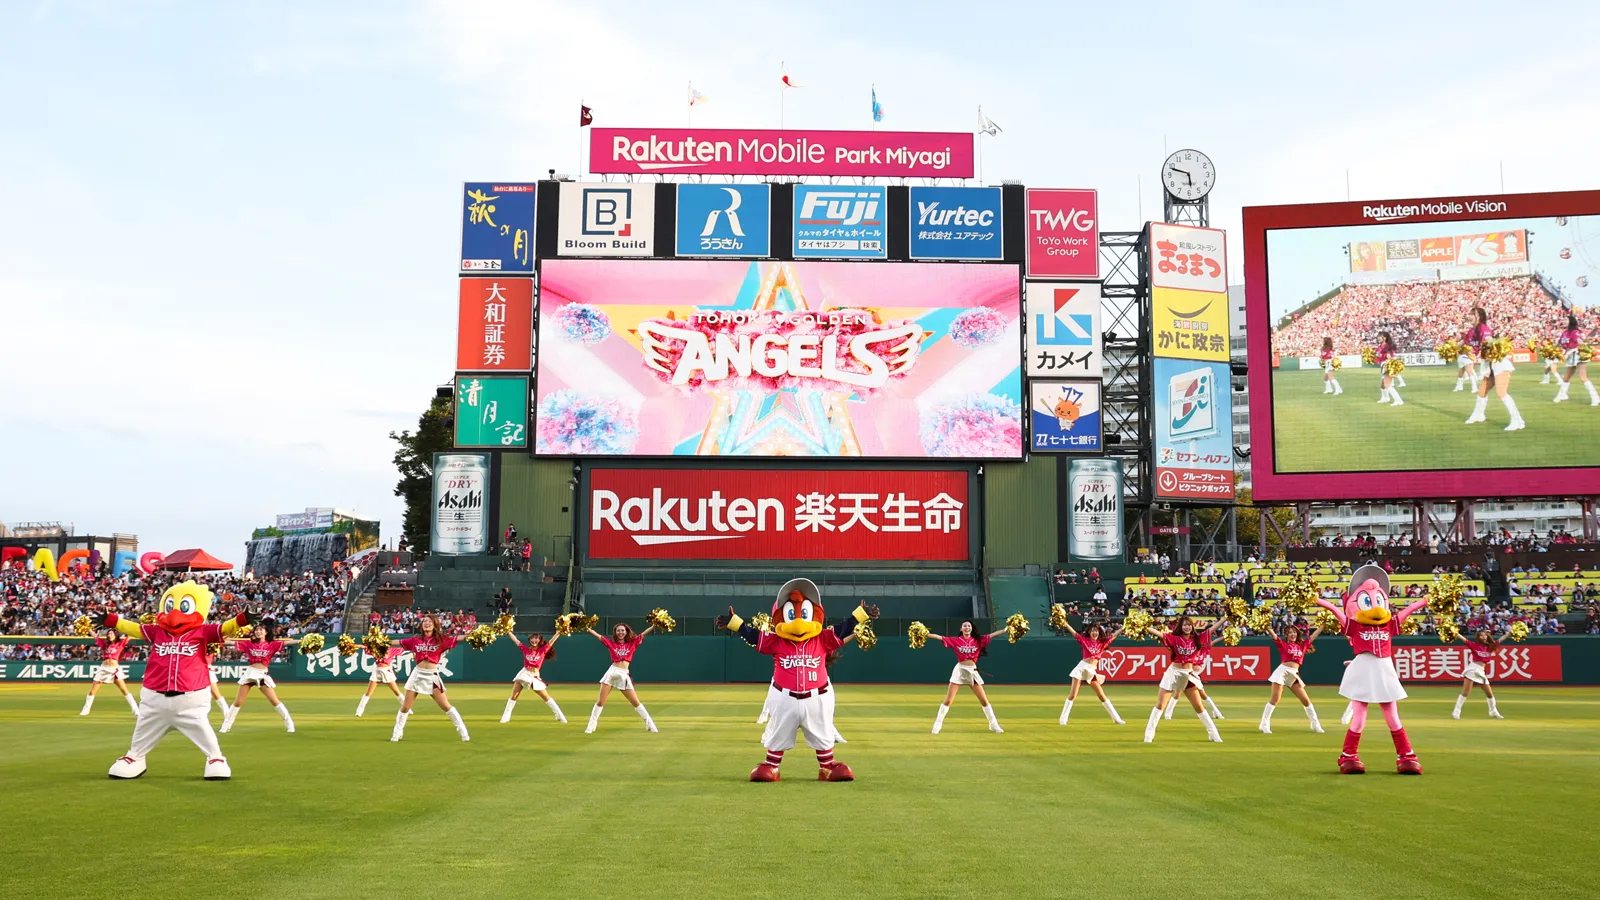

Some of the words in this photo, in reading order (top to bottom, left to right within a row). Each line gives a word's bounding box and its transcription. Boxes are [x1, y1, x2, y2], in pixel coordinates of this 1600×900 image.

[613, 135, 733, 163] Rakuten
[738, 138, 825, 164] Mobile
[835, 146, 882, 165] Park
[886, 147, 951, 169] Miyagi
[799, 191, 881, 225] Fuji
[917, 201, 994, 227] Yurtec
[1363, 204, 1419, 218] Rakuten
[1421, 203, 1463, 215] Mobile
[1465, 200, 1507, 213] Vision
[1030, 208, 1094, 232] TWG
[918, 231, 952, 240] 株式会社
[954, 231, 994, 241] ユアテック
[1037, 236, 1061, 246] ToYo
[1062, 236, 1088, 246] Work
[565, 240, 607, 249] Bloom
[612, 240, 646, 249] Build
[700, 238, 743, 250] ろうきん
[1179, 242, 1217, 252] 和風レストラン
[1046, 247, 1079, 258] Group
[1156, 239, 1221, 278] まるまつ
[1421, 247, 1454, 258] APPLE
[484, 282, 507, 365] 大和証券
[695, 313, 773, 325] TOHOKU
[788, 314, 868, 325] GOLDEN
[1158, 330, 1225, 352] かに政宗
[655, 328, 905, 388] ANGELS
[1036, 351, 1093, 370] カメイ
[1036, 433, 1048, 442] 77
[1049, 435, 1097, 445] 七十七銀行
[1183, 472, 1226, 482] グループシート
[438, 490, 482, 509] Asahi
[1074, 494, 1116, 513] Asahi
[454, 512, 465, 521] 生
[592, 488, 785, 532] Rakuten
[794, 491, 964, 534] 楽天生命
[1090, 516, 1100, 524] 生
[156, 645, 198, 657] EAGLES
[780, 657, 820, 669] EAGLES
[1127, 654, 1260, 676] アイオーヤマ
[808, 671, 818, 682] 10
